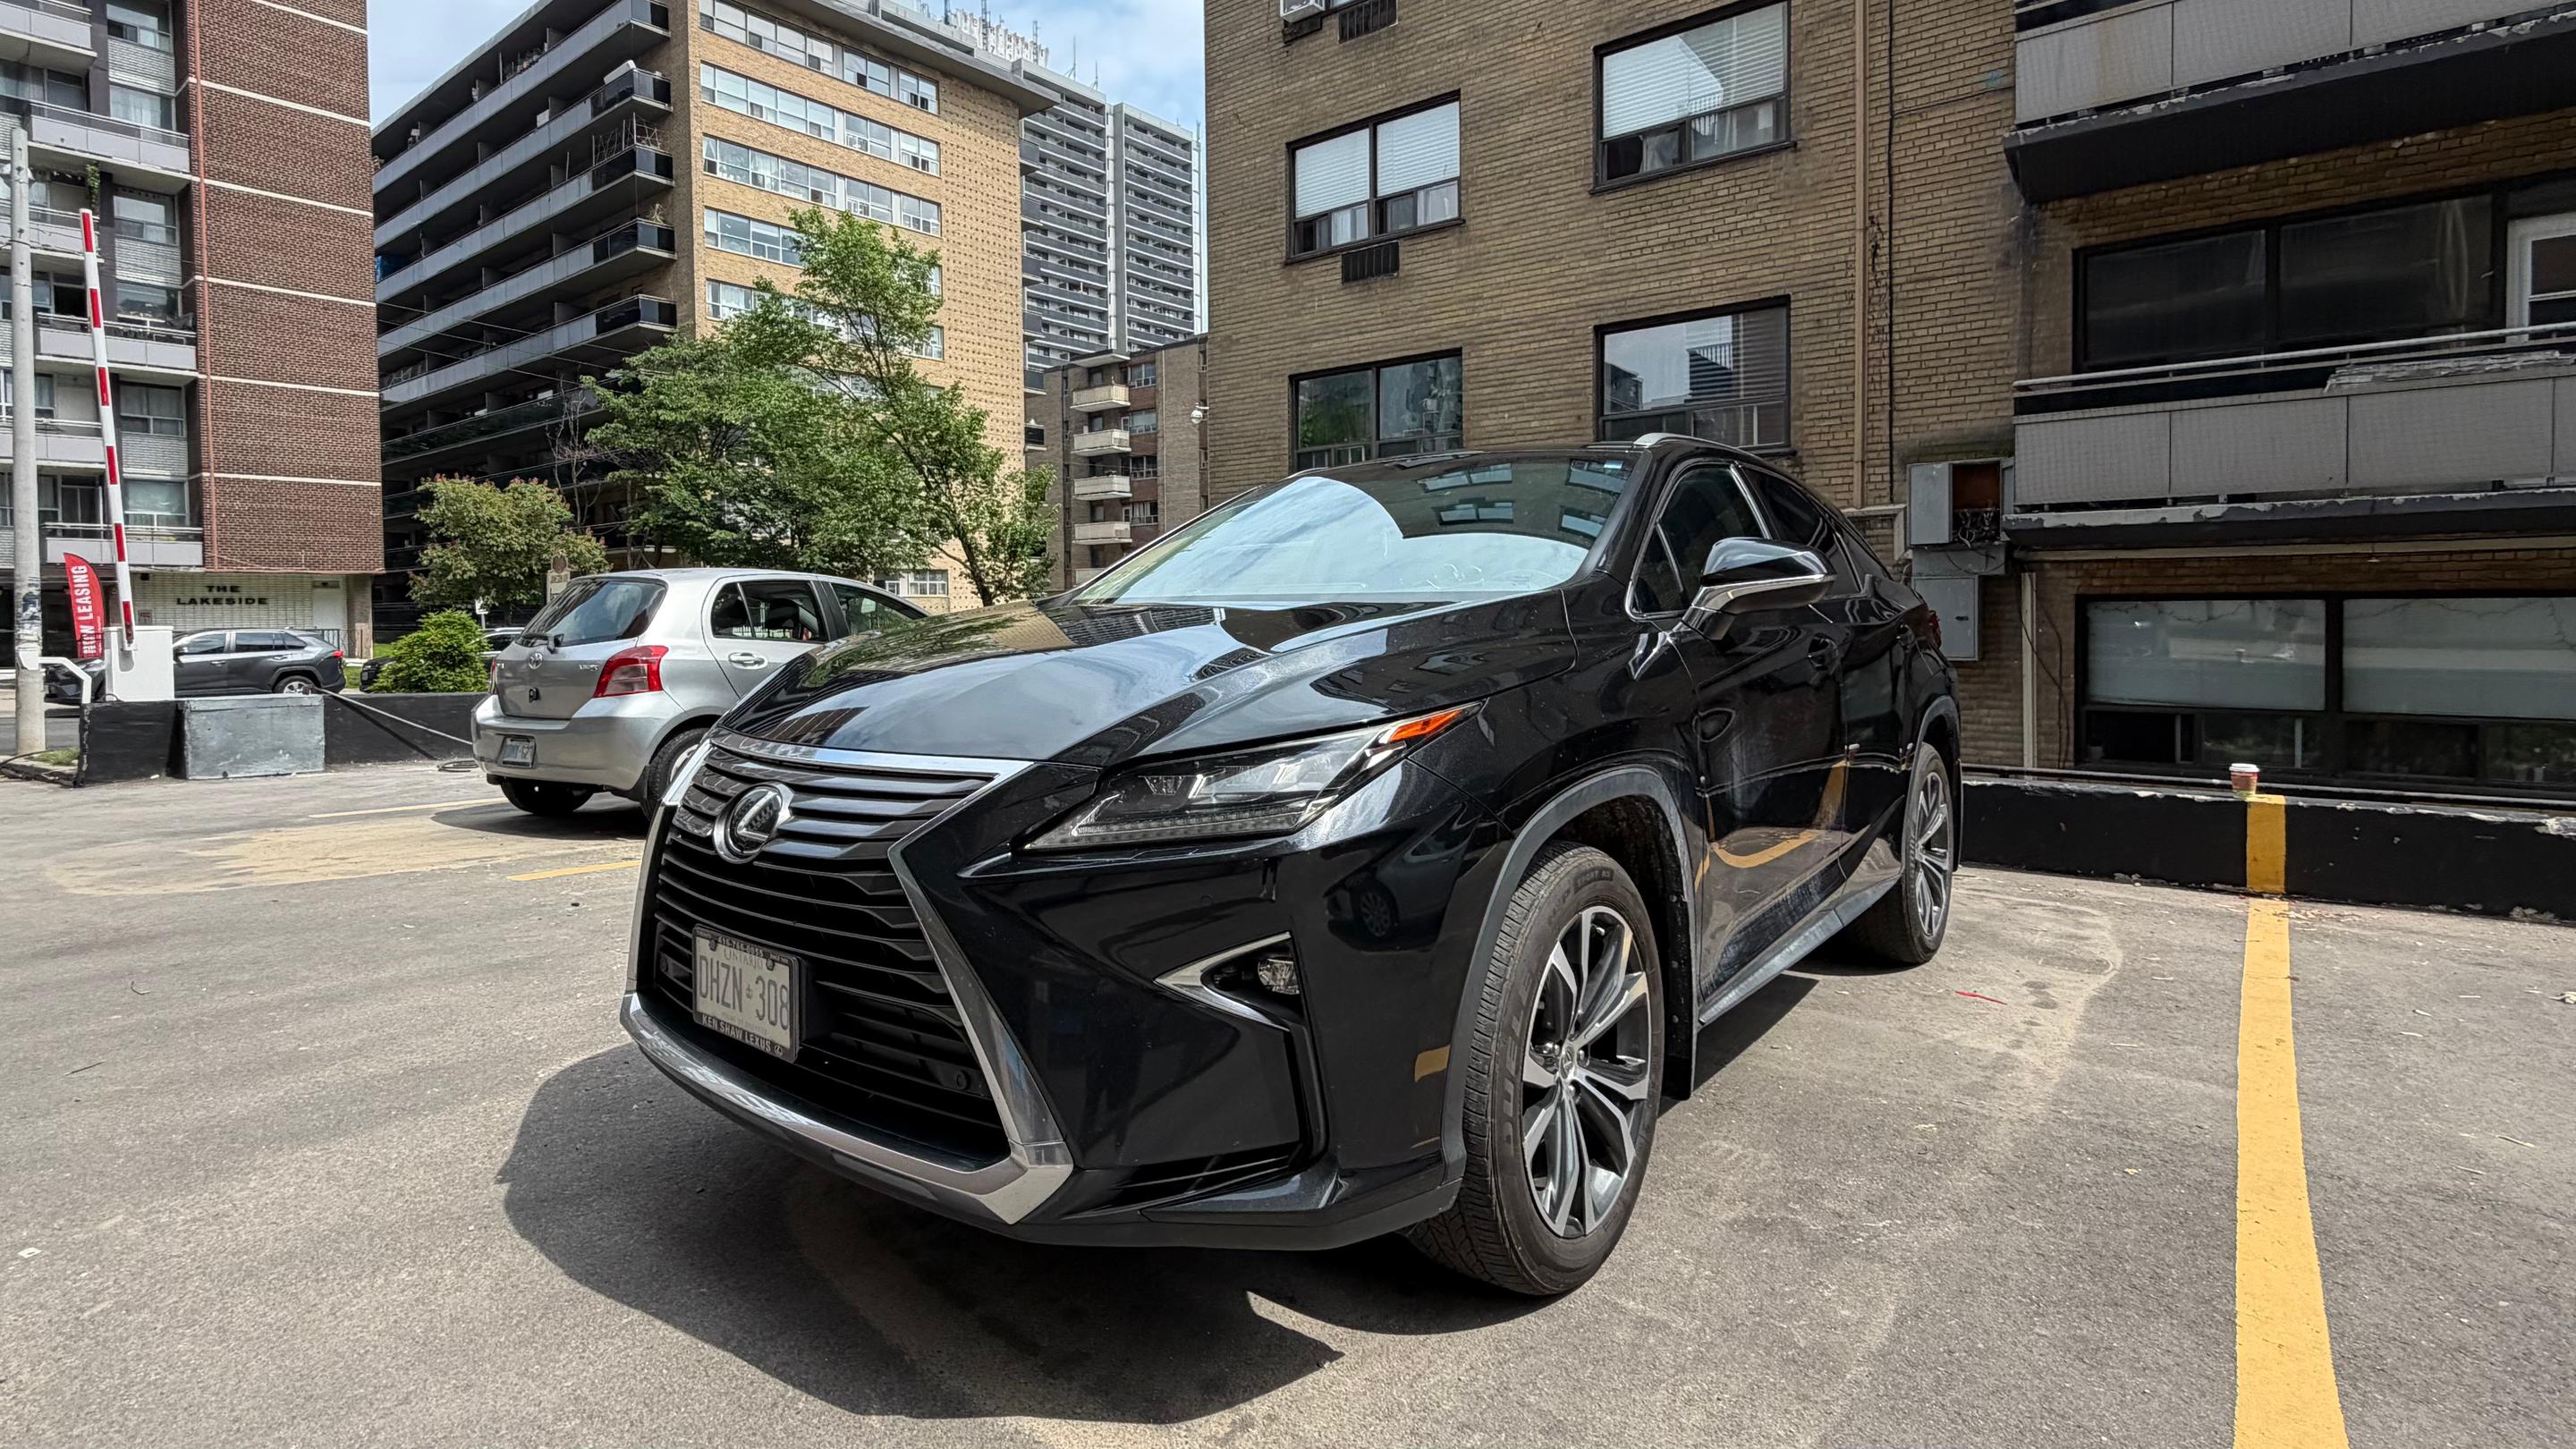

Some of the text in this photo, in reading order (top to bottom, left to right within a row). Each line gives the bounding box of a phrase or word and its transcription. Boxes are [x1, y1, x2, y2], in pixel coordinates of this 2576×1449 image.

[71, 564, 93, 621] LEASING
[176, 597, 268, 606] LAKESIDE
[206, 585, 241, 593] THE
[724, 947, 763, 970] ONTARIO
[699, 954, 789, 1031] DHZN 308
[702, 1013, 718, 1030] KEN
[719, 1021, 743, 1039] SHAW
[744, 1031, 772, 1053] LEXUS
